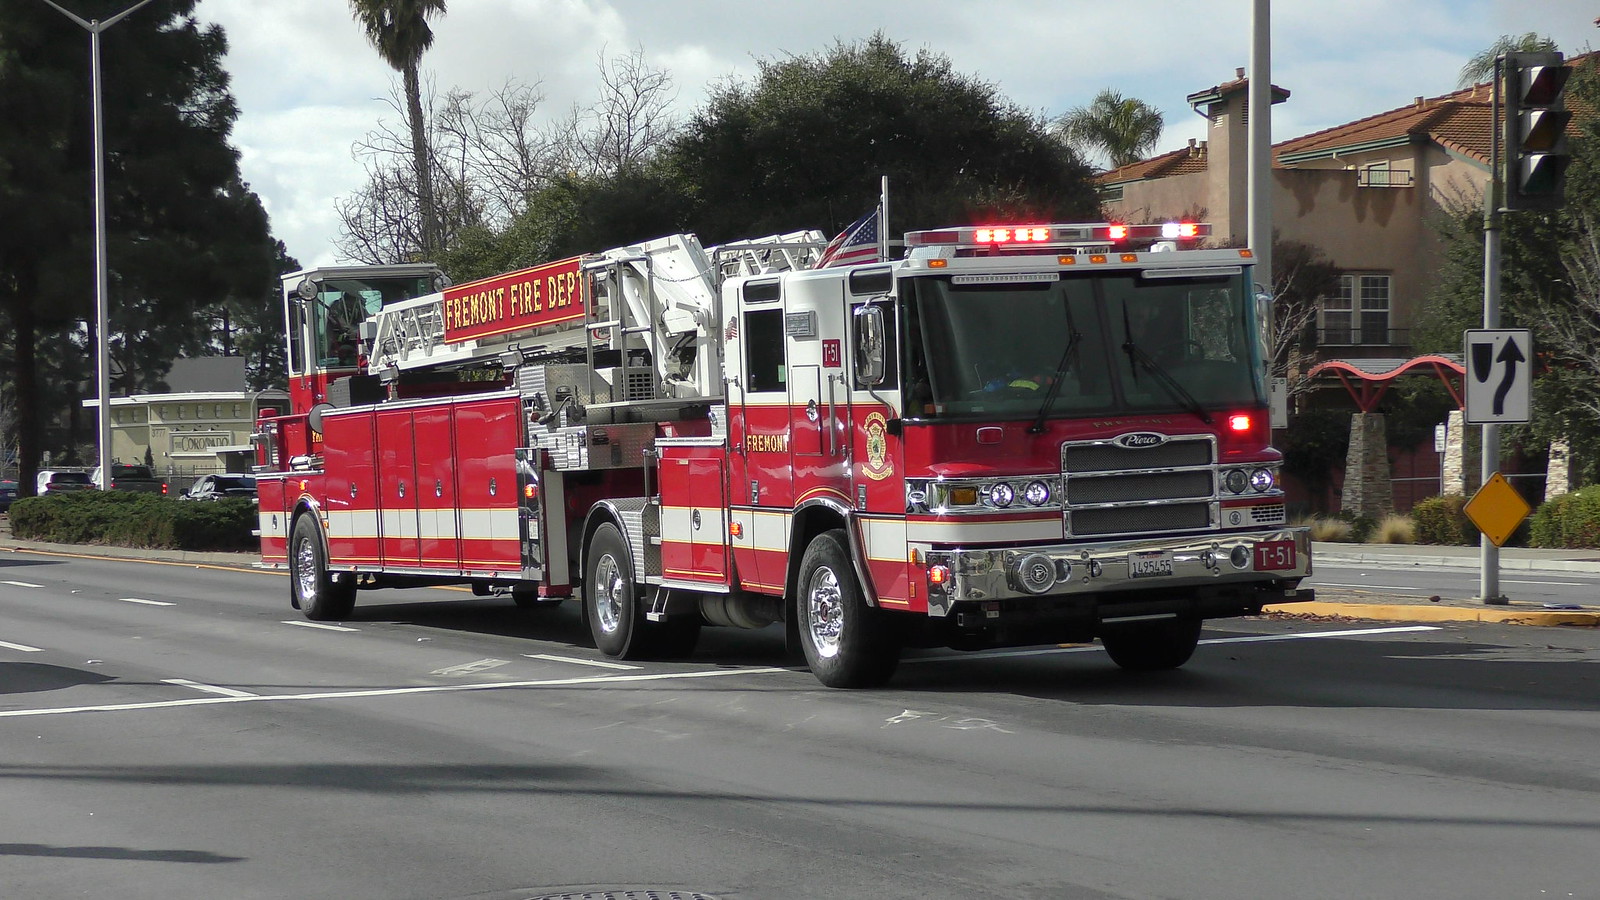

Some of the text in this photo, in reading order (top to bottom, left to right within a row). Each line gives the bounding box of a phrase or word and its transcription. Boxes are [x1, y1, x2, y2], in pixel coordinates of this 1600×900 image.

[446, 269, 583, 330] FREMONT FIRE DEPT
[823, 343, 838, 362] T-51
[746, 434, 788, 452] FREMONT
[1125, 436, 1157, 446] Pierce
[1259, 546, 1292, 566] T-51
